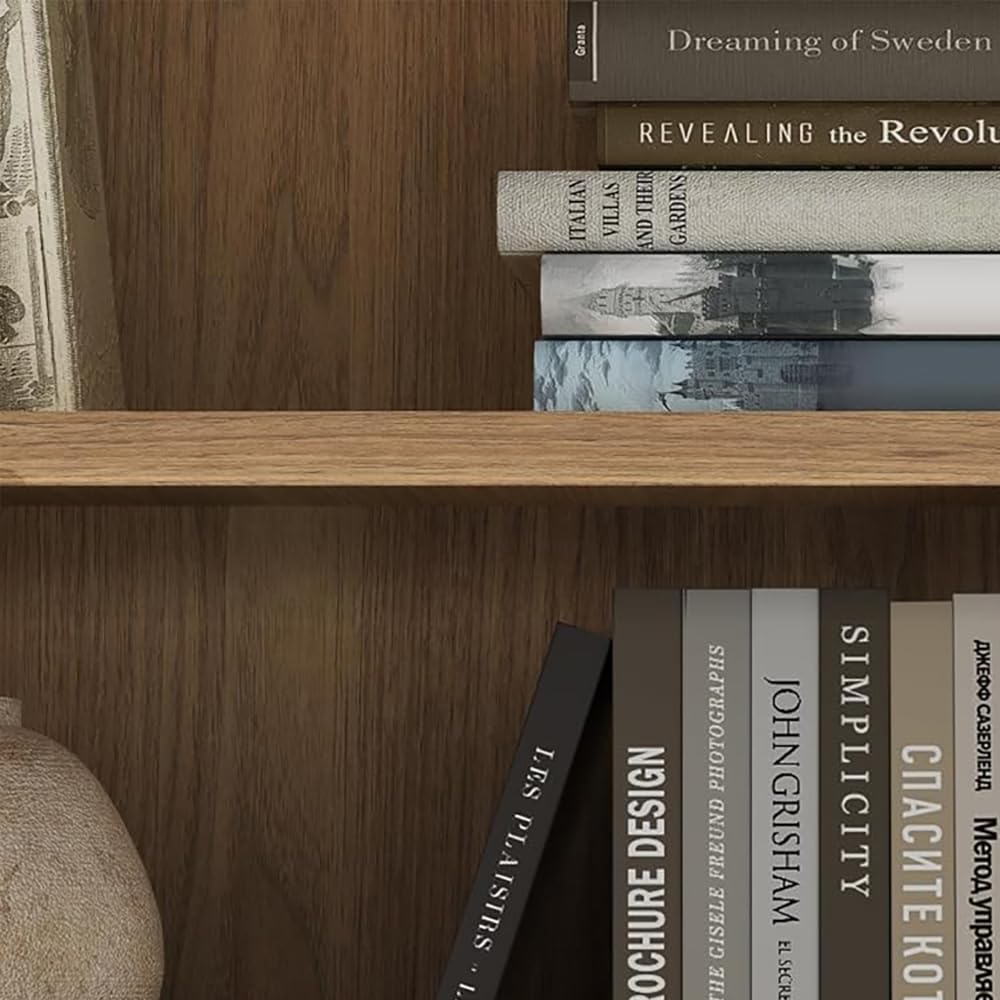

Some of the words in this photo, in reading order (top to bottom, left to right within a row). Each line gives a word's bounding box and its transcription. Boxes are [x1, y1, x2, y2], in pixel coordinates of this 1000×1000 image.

[574, 24, 586, 57] Granta
[668, 29, 822, 57] Dreaming
[831, 28, 863, 52] of
[870, 28, 993, 52] Sweden
[639, 122, 814, 145] REVEALING
[829, 125, 868, 145] the
[568, 179, 586, 241] ITALIAN
[602, 182, 620, 237] VILLAS
[635, 170, 654, 216] THEIR
[668, 175, 688, 246] GARDENS
[636, 218, 654, 249] AND
[973, 639, 992, 701] ДЖЕФФ
[708, 643, 726, 793] PHOTOGRAPHS
[763, 676, 802, 766] JOHN
[974, 703, 993, 792] САЗЕРЛЕНД
[520, 745, 556, 801] LES
[840, 624, 870, 898] SIMPLICITY
[627, 746, 666, 858] DESIGN
[901, 744, 944, 922] СПАСИТЕ
[708, 797, 726, 880] FREUND
[771, 772, 802, 925] GRISHAM
[971, 817, 998, 894] Метод
[472, 812, 534, 952] PLAISIRS
[708, 886, 726, 960] GISELE
[777, 940, 791, 955] EL
